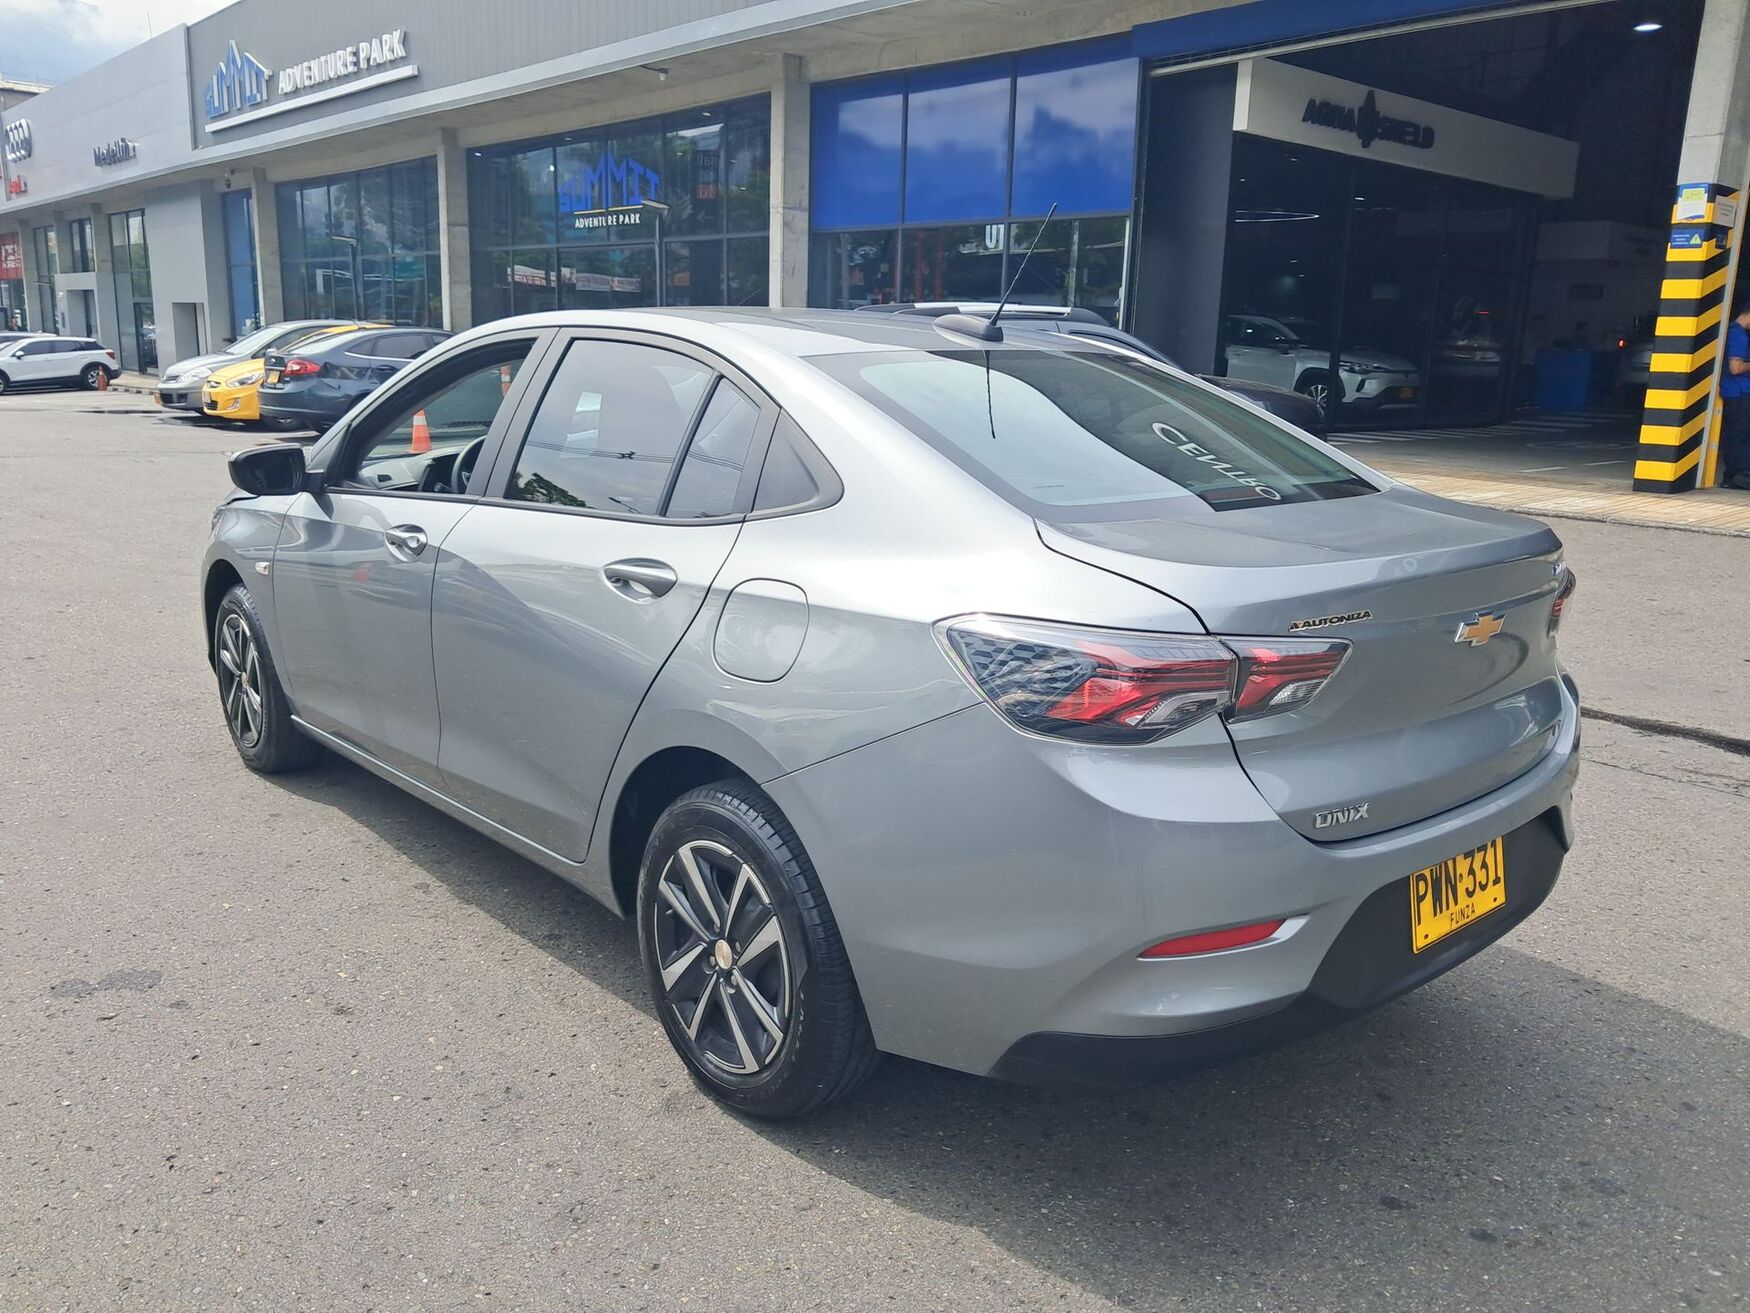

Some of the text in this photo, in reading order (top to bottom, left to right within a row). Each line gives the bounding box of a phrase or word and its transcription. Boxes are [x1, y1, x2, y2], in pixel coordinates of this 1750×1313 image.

[278, 29, 407, 95] ADVENTURE PARK
[575, 213, 641, 229] ADVENTURE PARK
[1301, 610, 1372, 630] AUTONIZA
[1314, 802, 1369, 829] ONIX
[1449, 902, 1476, 928] FUNZA
